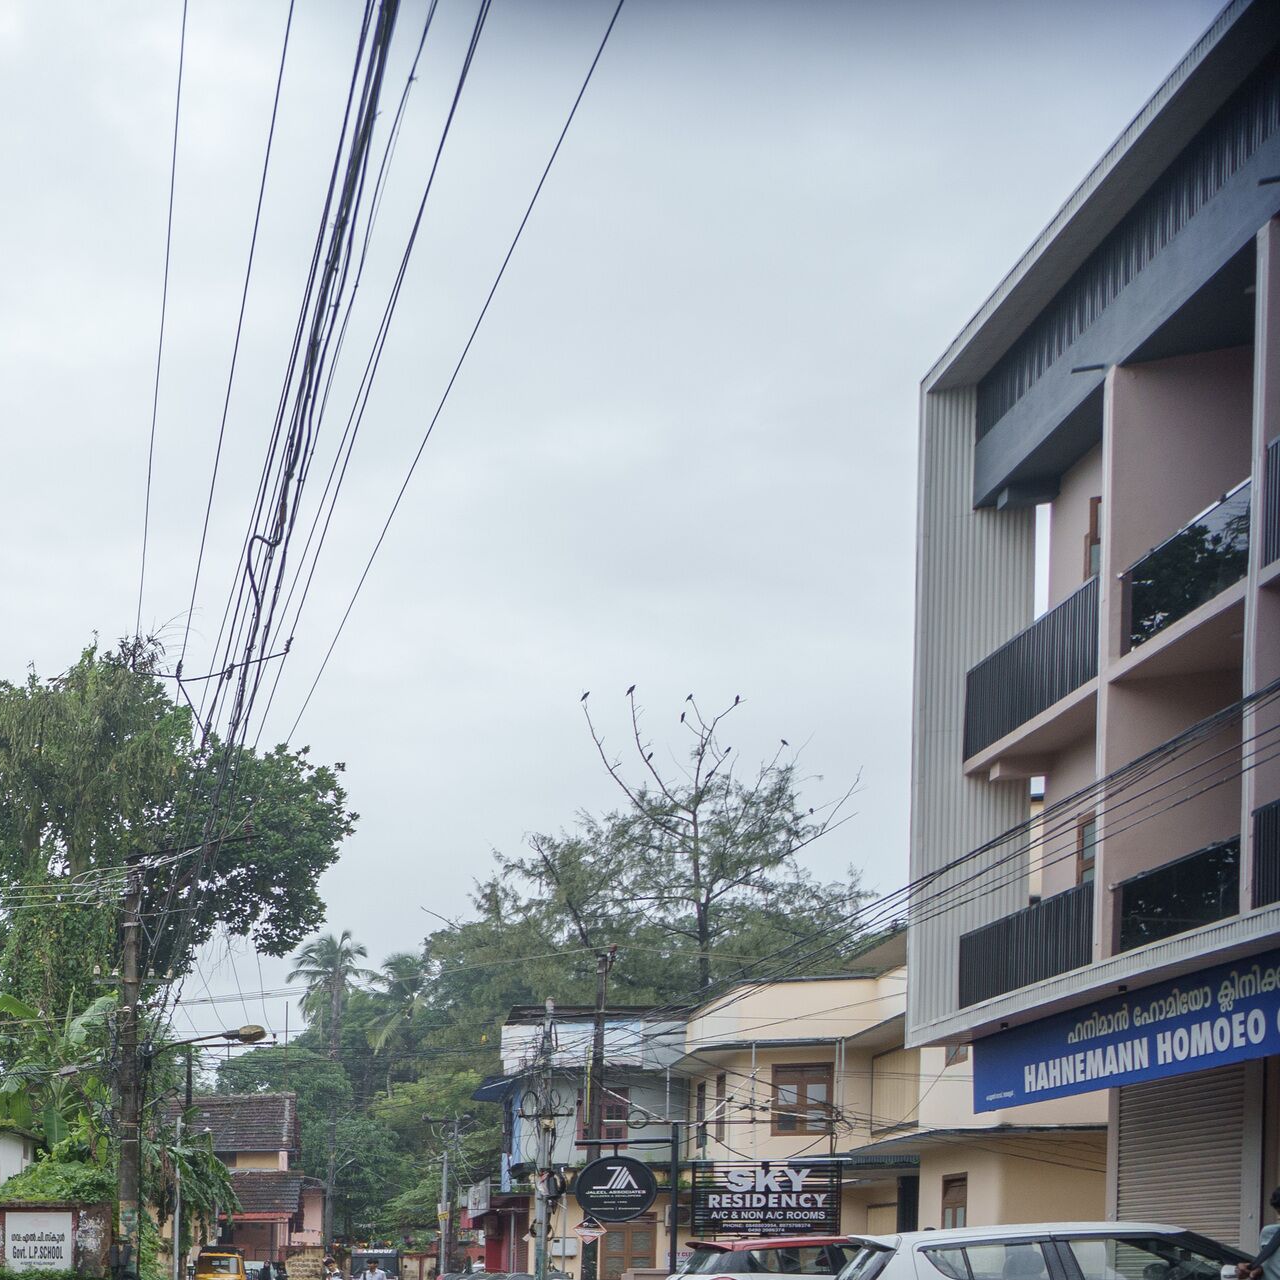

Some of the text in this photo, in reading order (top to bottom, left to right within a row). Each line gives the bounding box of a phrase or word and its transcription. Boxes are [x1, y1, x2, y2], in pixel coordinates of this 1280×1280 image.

[1024, 1008, 1266, 1093] HAHNEMANN HOMOEO
[725, 1168, 811, 1192] SKY
[708, 1193, 827, 1208] RESIDENCY
[710, 1211, 826, 1219] A/C & NON A/C ROOMS
[12, 1245, 28, 1259] Govt.
